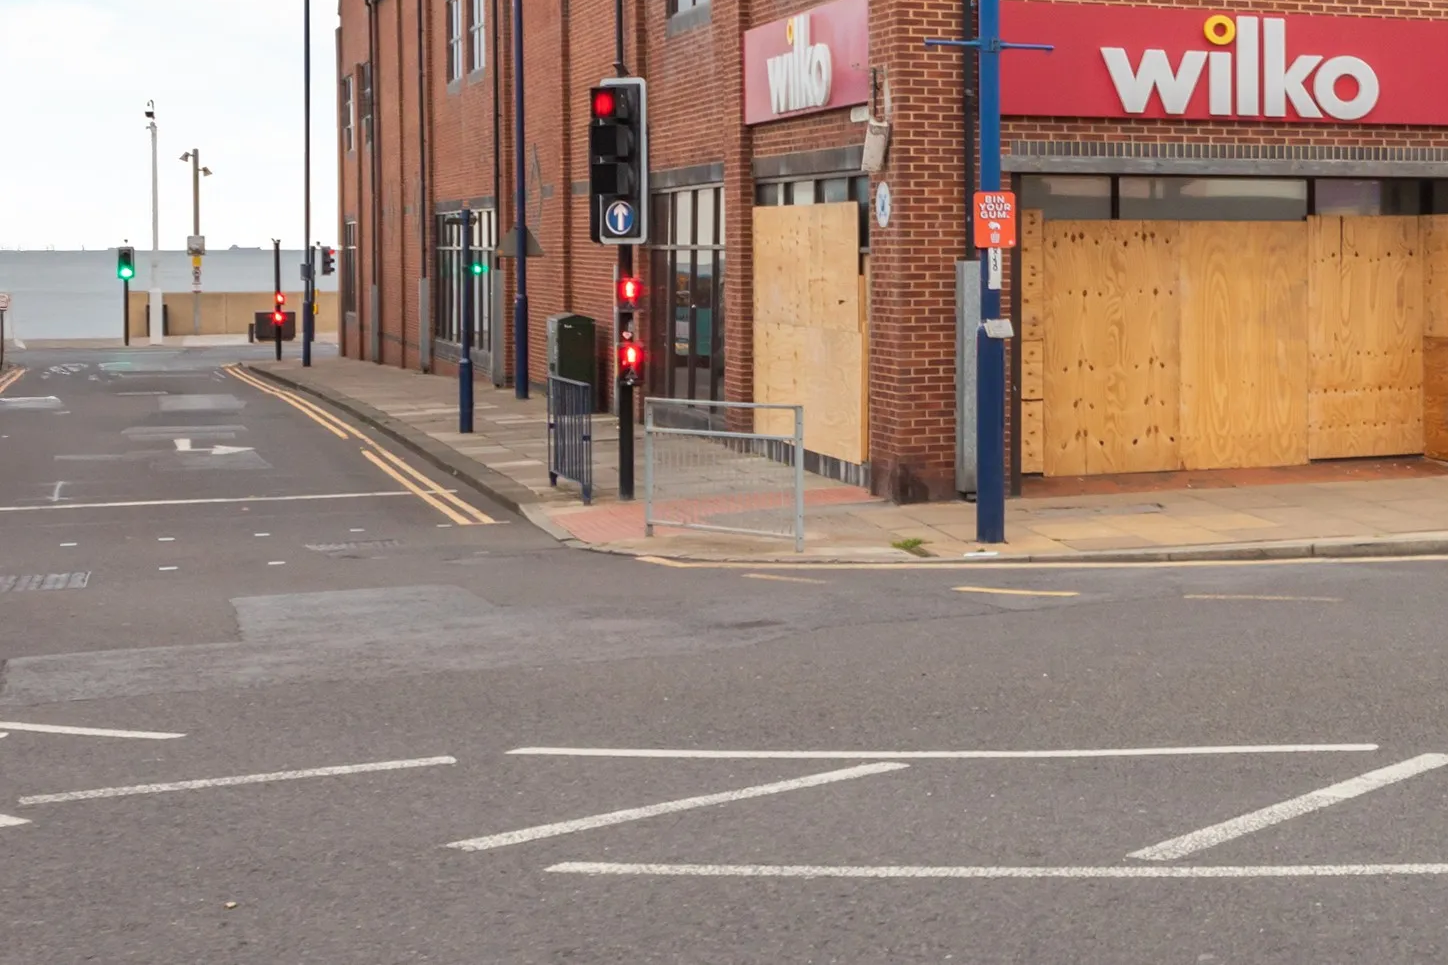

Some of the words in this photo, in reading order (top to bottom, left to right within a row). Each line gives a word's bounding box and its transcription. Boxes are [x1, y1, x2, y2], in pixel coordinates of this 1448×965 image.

[766, 13, 831, 114] wilko
[1099, 14, 1380, 120] wilko
[979, 202, 1012, 211] YOUR
[984, 195, 1005, 203] BIN
